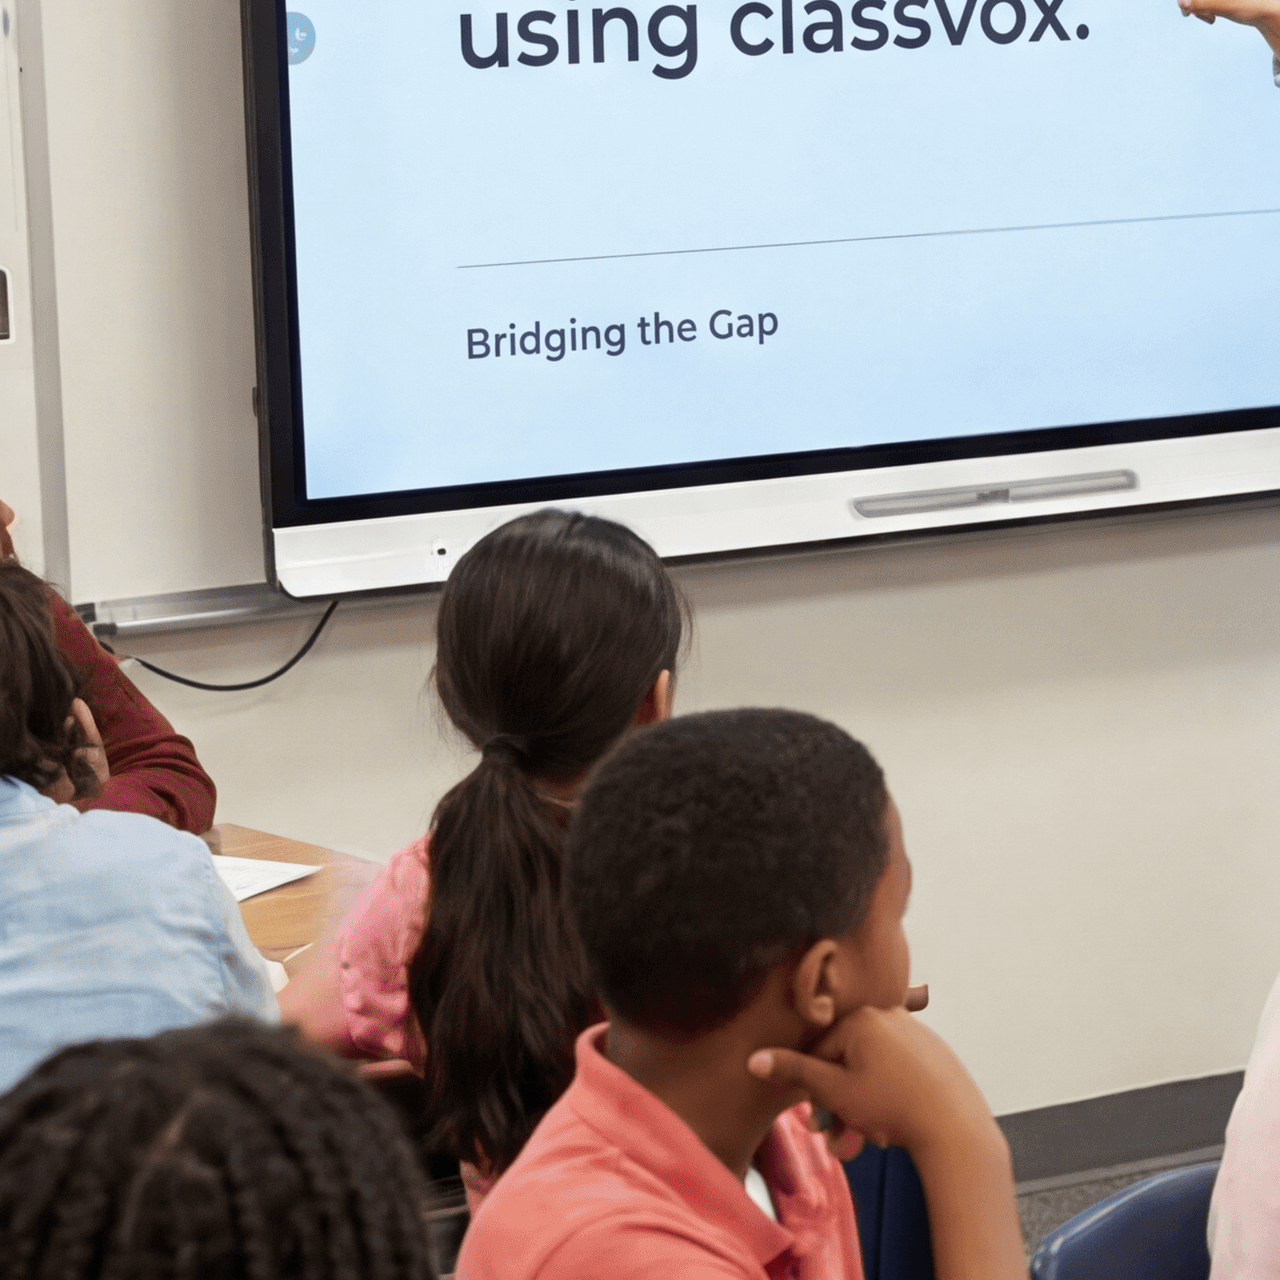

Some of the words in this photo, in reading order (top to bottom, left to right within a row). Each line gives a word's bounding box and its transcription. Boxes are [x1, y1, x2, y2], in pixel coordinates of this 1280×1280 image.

[466, 319, 627, 363] Bridging
[636, 310, 698, 347] the
[708, 308, 780, 346] Gap
